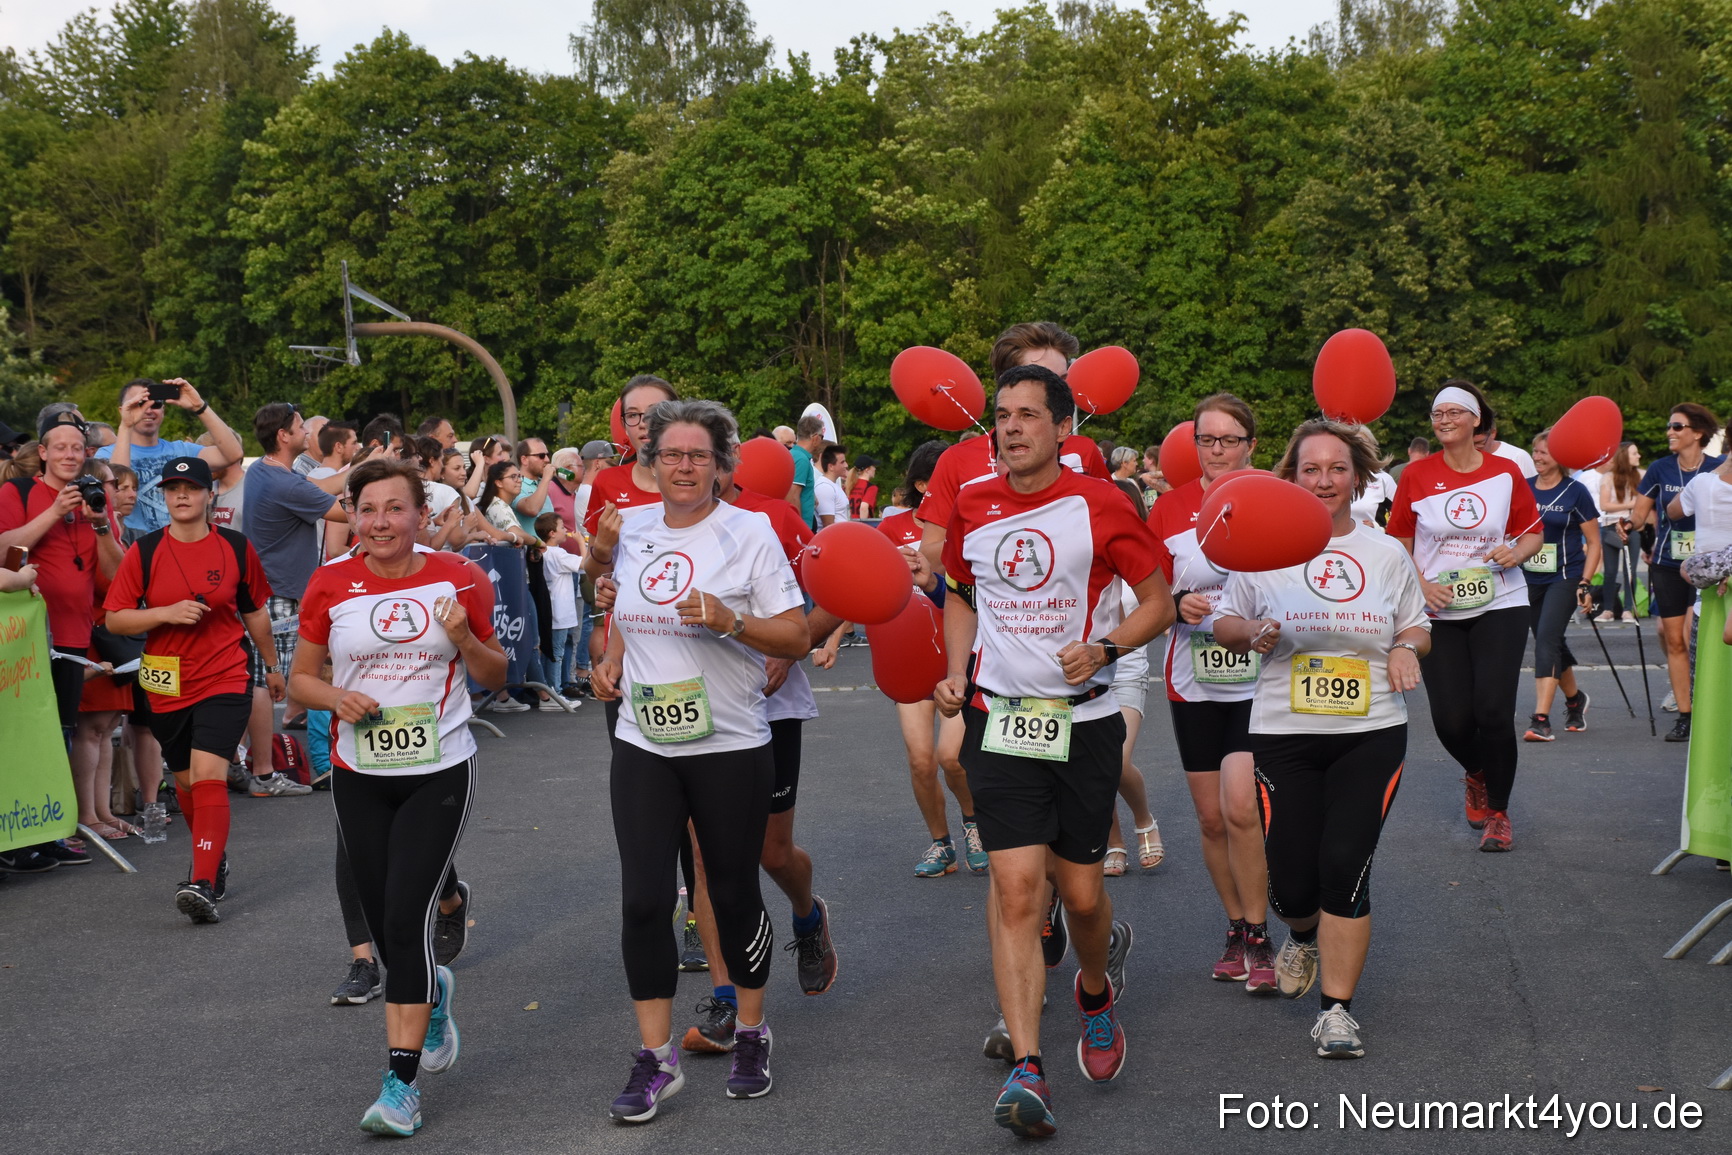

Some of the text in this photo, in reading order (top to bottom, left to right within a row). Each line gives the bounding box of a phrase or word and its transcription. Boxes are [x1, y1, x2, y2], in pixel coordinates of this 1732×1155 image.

[1678, 542, 1695, 552] 71
[1529, 554, 1547, 564] 06
[207, 570, 220, 581] 25
[1451, 581, 1488, 599] 896
[1022, 600, 1042, 609] MIT
[1048, 598, 1077, 609] HERZ
[618, 611, 654, 624] LAUFEN
[658, 616, 675, 626] MIT
[1286, 611, 1388, 624] LAUFEN MIT HERZ
[663, 629, 673, 637] Dr.
[675, 631, 700, 639] Röschl
[1355, 626, 1381, 635] Röschl
[349, 652, 389, 661] LAUFEN
[419, 651, 444, 661] HERZ
[1200, 650, 1251, 668] 1904
[140, 666, 172, 685] 352
[1302, 676, 1360, 700] 1898
[641, 701, 699, 726] 1895
[999, 715, 1059, 741] 1899
[364, 726, 427, 752] 1903
[1020, 740, 1050, 748] Johannes
